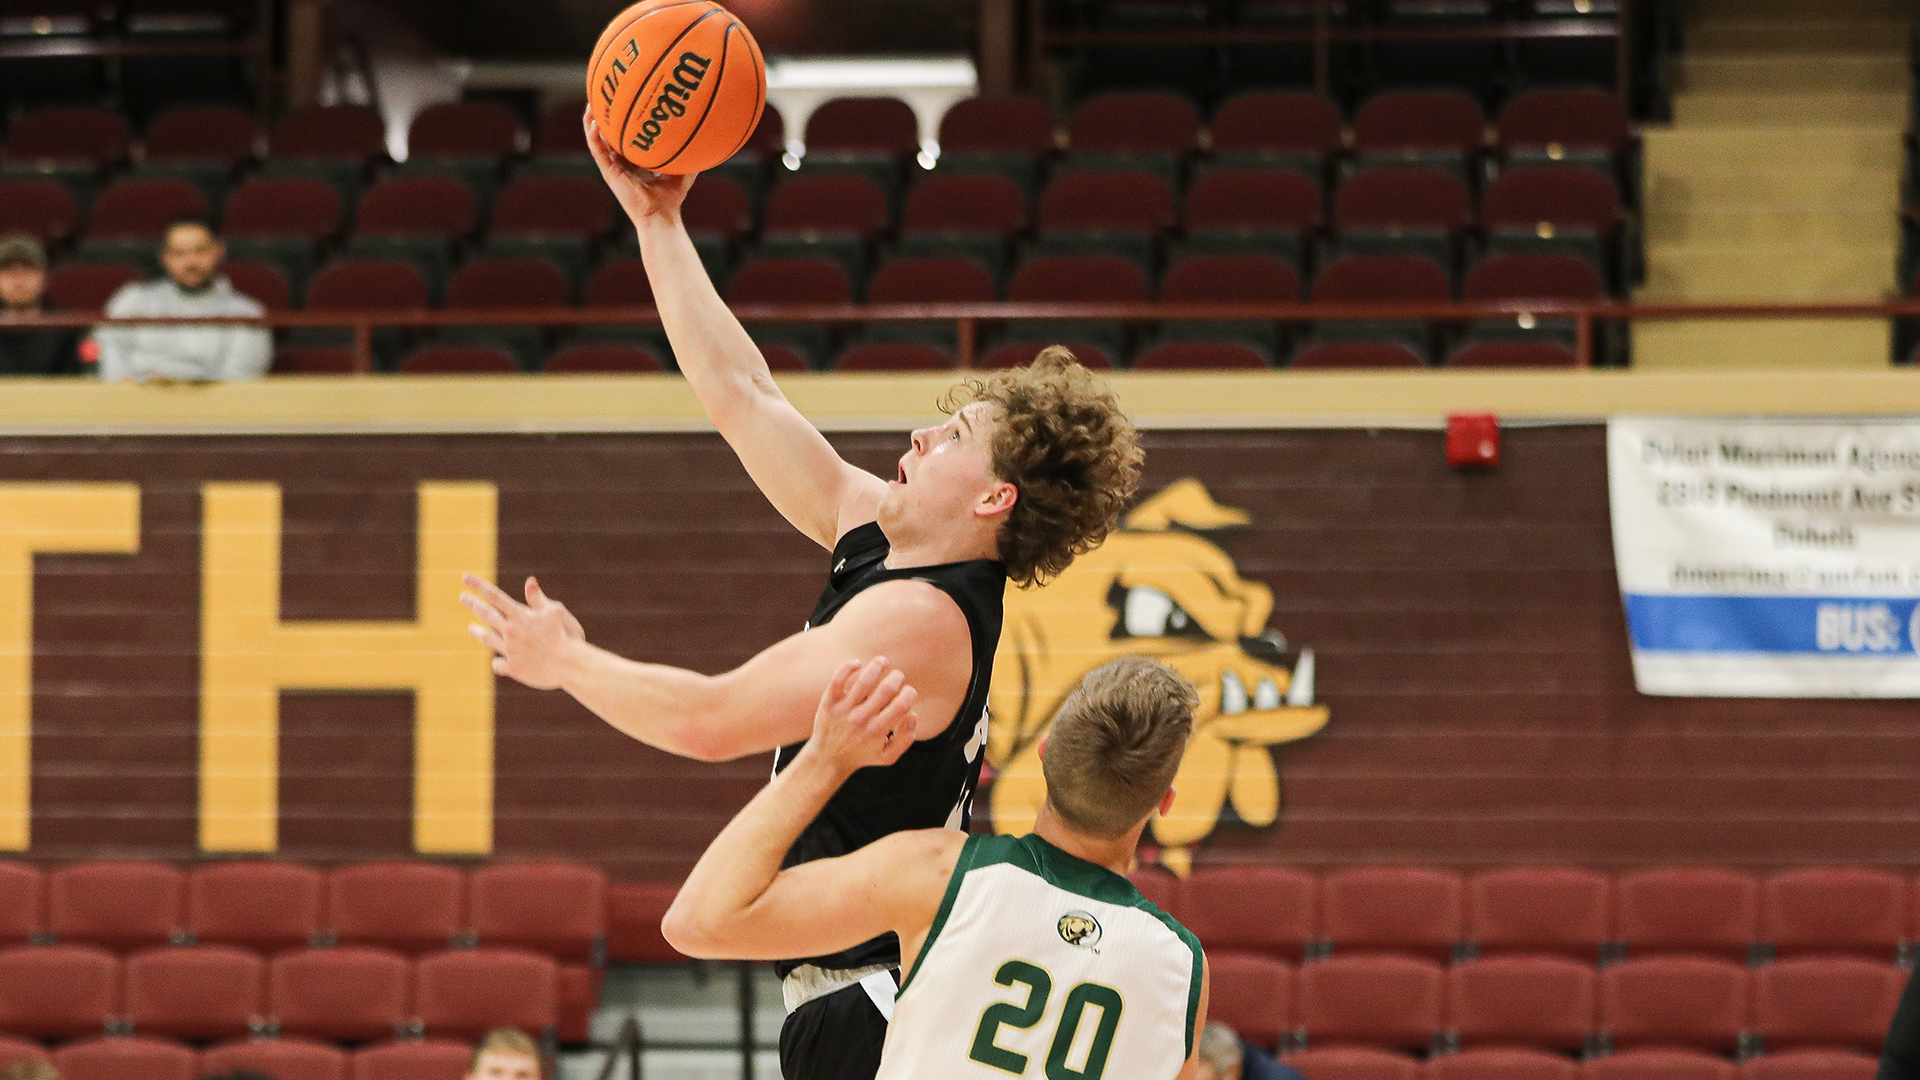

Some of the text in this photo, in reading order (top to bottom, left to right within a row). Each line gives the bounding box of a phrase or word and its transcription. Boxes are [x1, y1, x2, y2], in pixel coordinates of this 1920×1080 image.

[601, 38, 639, 106] EVO
[631, 51, 712, 152] Wilson
[1815, 603, 1900, 651] BUS:
[968, 959, 1124, 1080] 20
